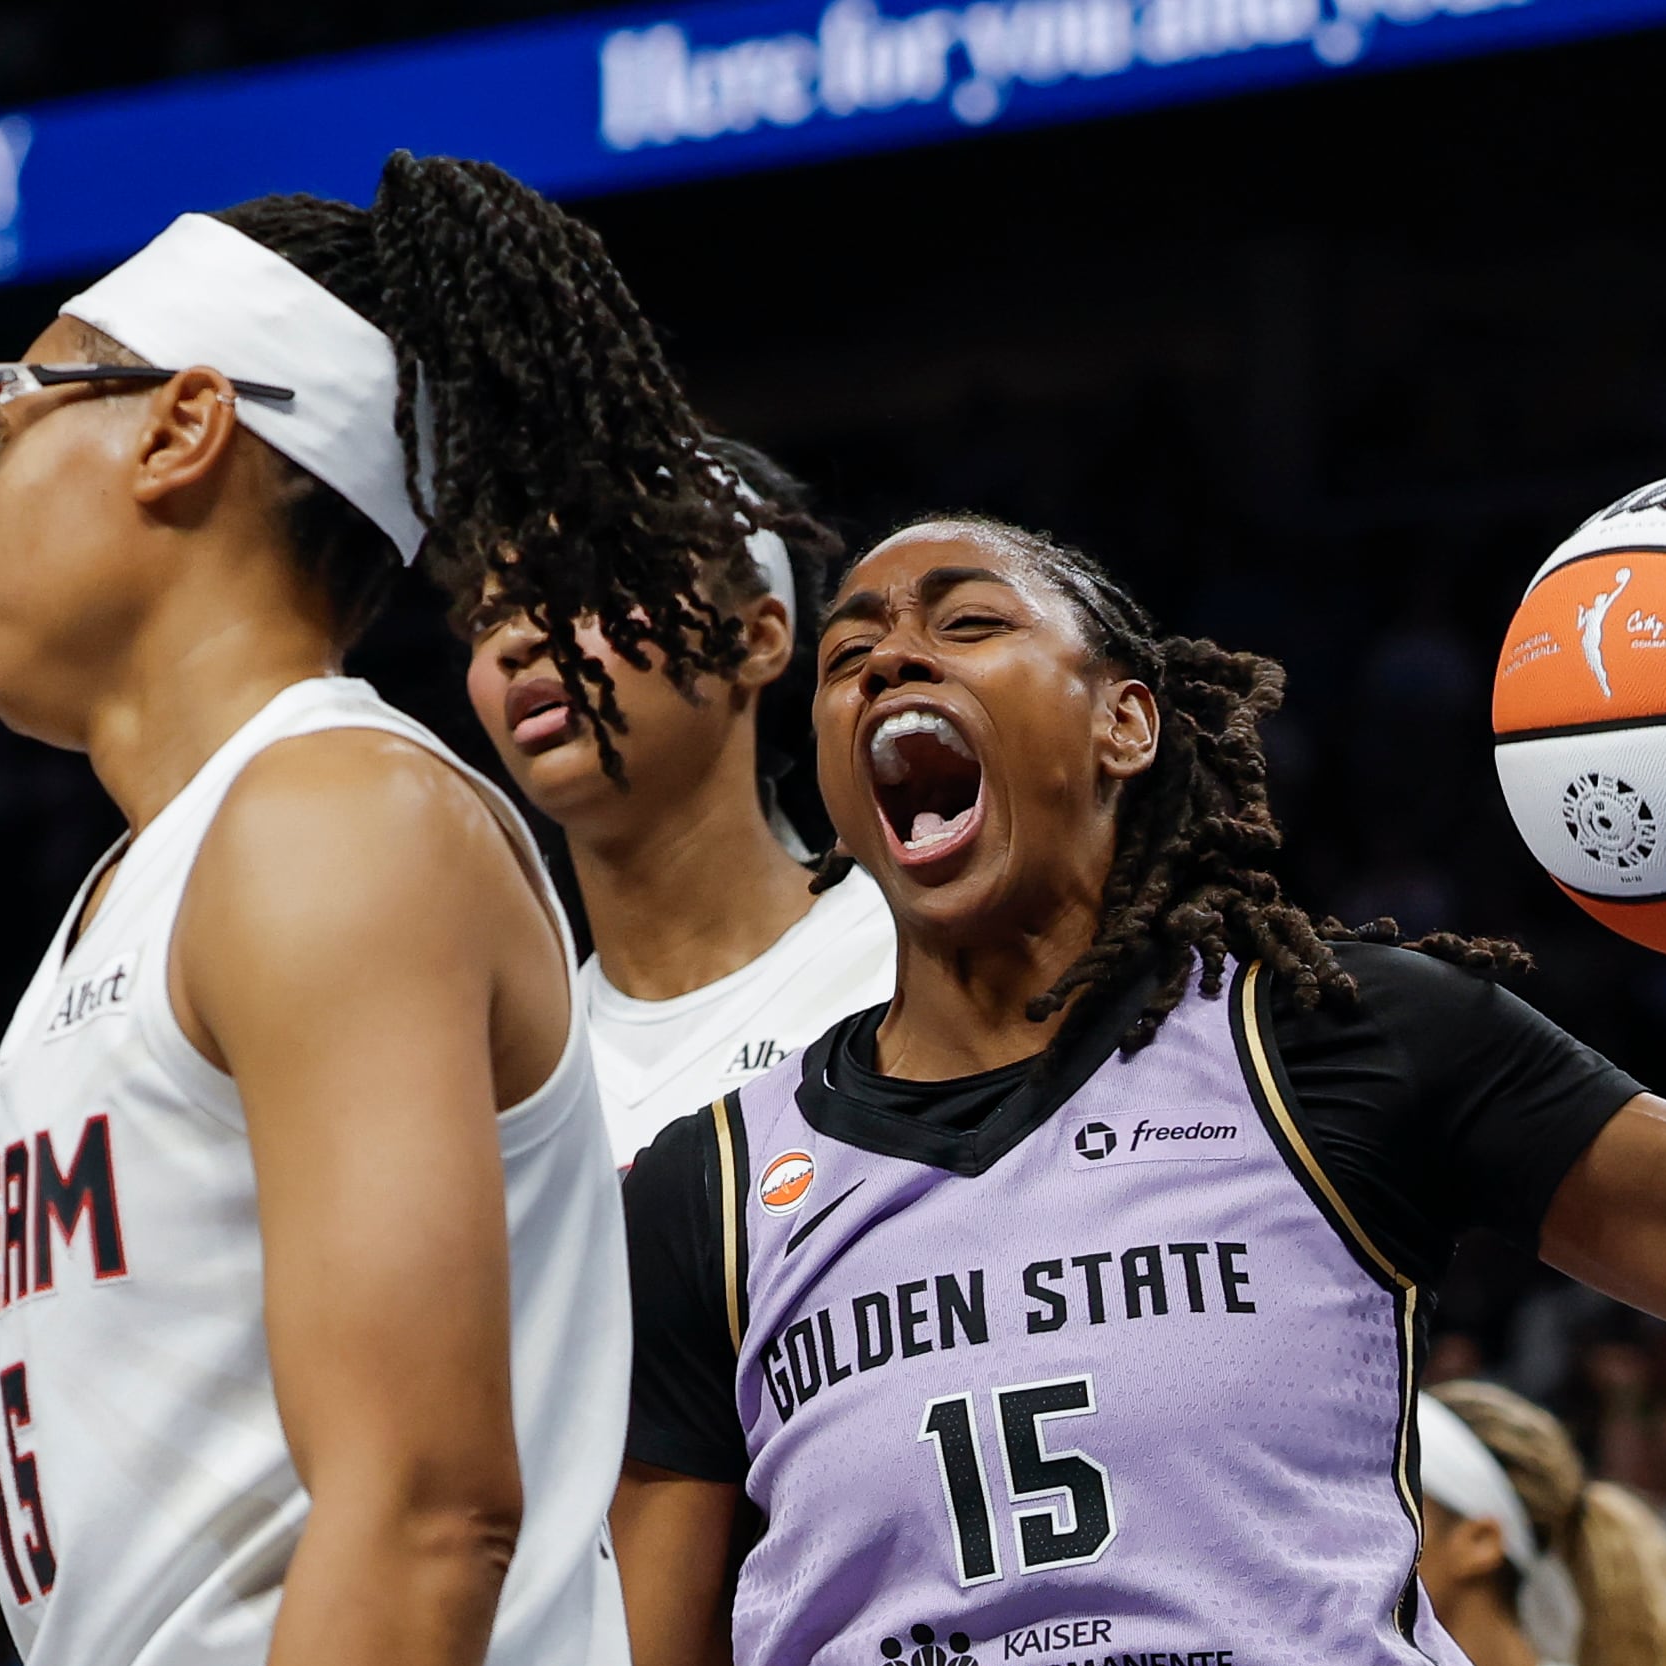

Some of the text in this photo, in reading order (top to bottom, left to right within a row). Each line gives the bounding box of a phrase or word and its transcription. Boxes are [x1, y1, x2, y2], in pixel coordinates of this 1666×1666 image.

[600, 22, 819, 149] Here
[818, 0, 953, 117] for
[947, 1, 1134, 125] you
[725, 1038, 791, 1074] Alb
[1130, 1118, 1237, 1152] freedom
[761, 1242, 1256, 1424] GOLDEN STATE
[917, 1373, 1119, 1588] 15
[1004, 1619, 1112, 1661] KAISER
